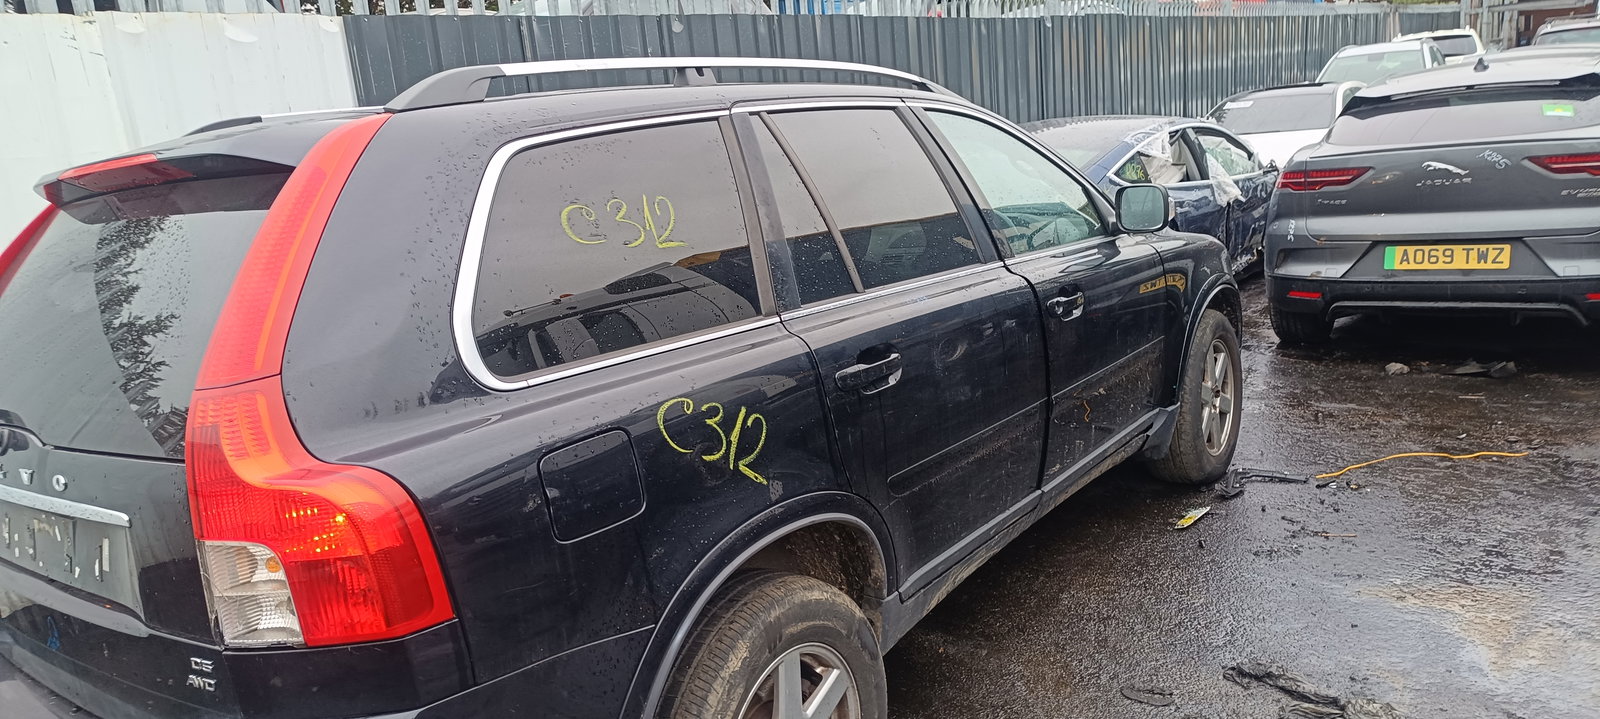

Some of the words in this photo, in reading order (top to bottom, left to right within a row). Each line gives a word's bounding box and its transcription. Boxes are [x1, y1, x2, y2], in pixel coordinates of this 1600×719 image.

[1416, 178, 1472, 187] JAGUAR
[1462, 247, 1505, 264] TWZ
[186, 675, 216, 691] AWD
